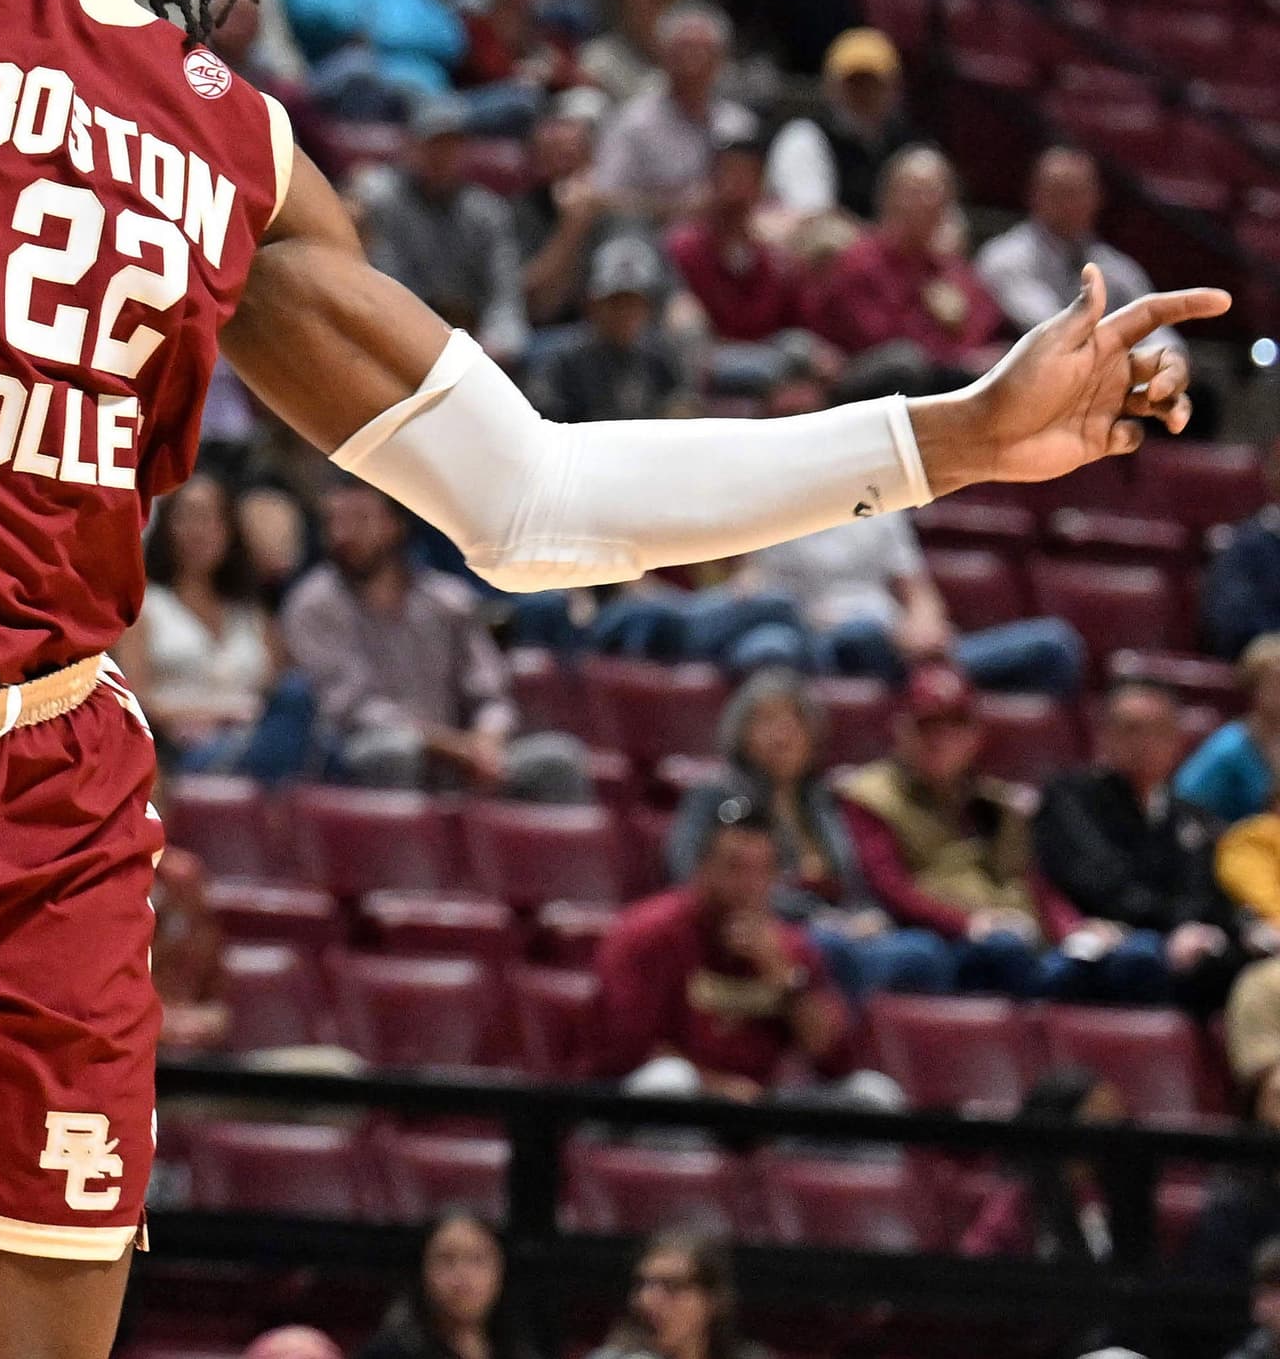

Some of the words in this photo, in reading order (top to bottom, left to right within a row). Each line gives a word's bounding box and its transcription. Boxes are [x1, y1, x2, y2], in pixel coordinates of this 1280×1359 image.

[188, 64, 226, 84] ACC
[4, 176, 190, 380] 22
[39, 1110, 124, 1211] BC
